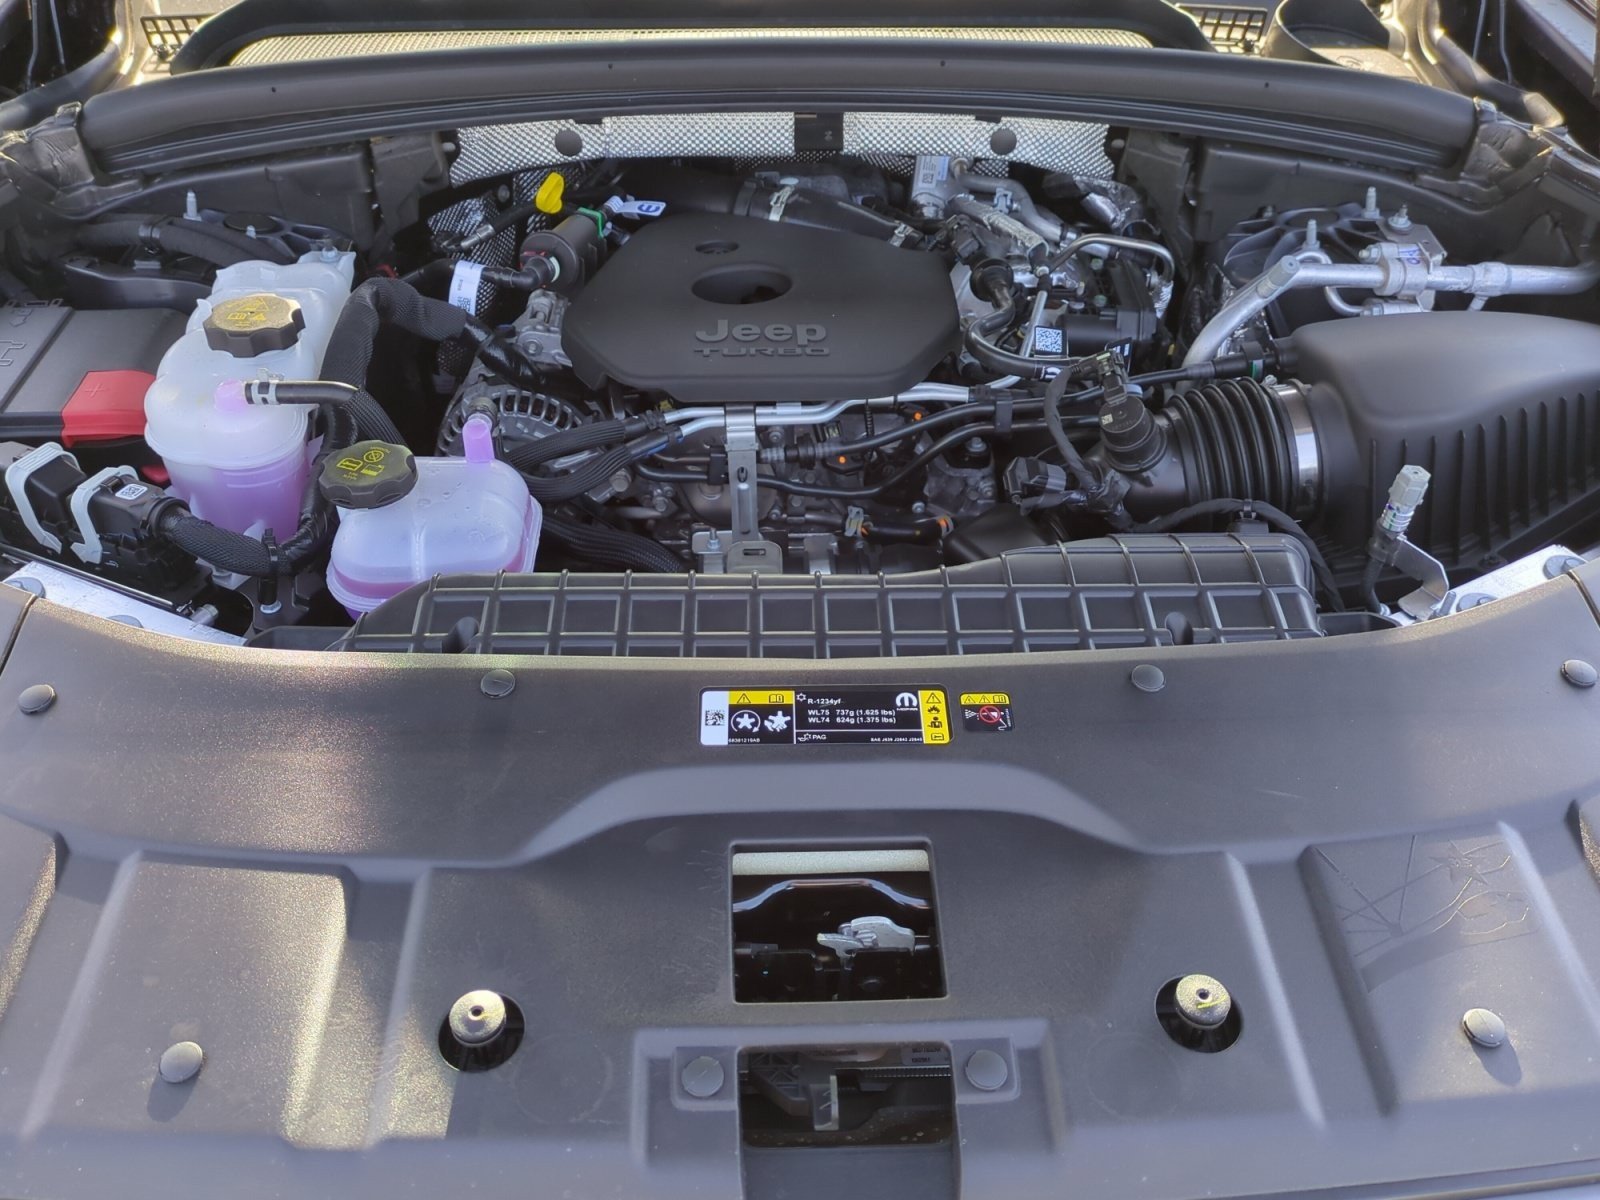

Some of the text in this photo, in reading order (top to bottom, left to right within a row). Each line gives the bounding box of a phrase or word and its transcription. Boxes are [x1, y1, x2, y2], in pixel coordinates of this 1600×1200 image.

[695, 319, 827, 347] Jeep
[693, 347, 830, 357] TURBO
[807, 698, 842, 706] R-1234yf
[836, 709, 854, 717] 737g
[856, 709, 879, 717] (1.625
[881, 709, 896, 717] lbs)
